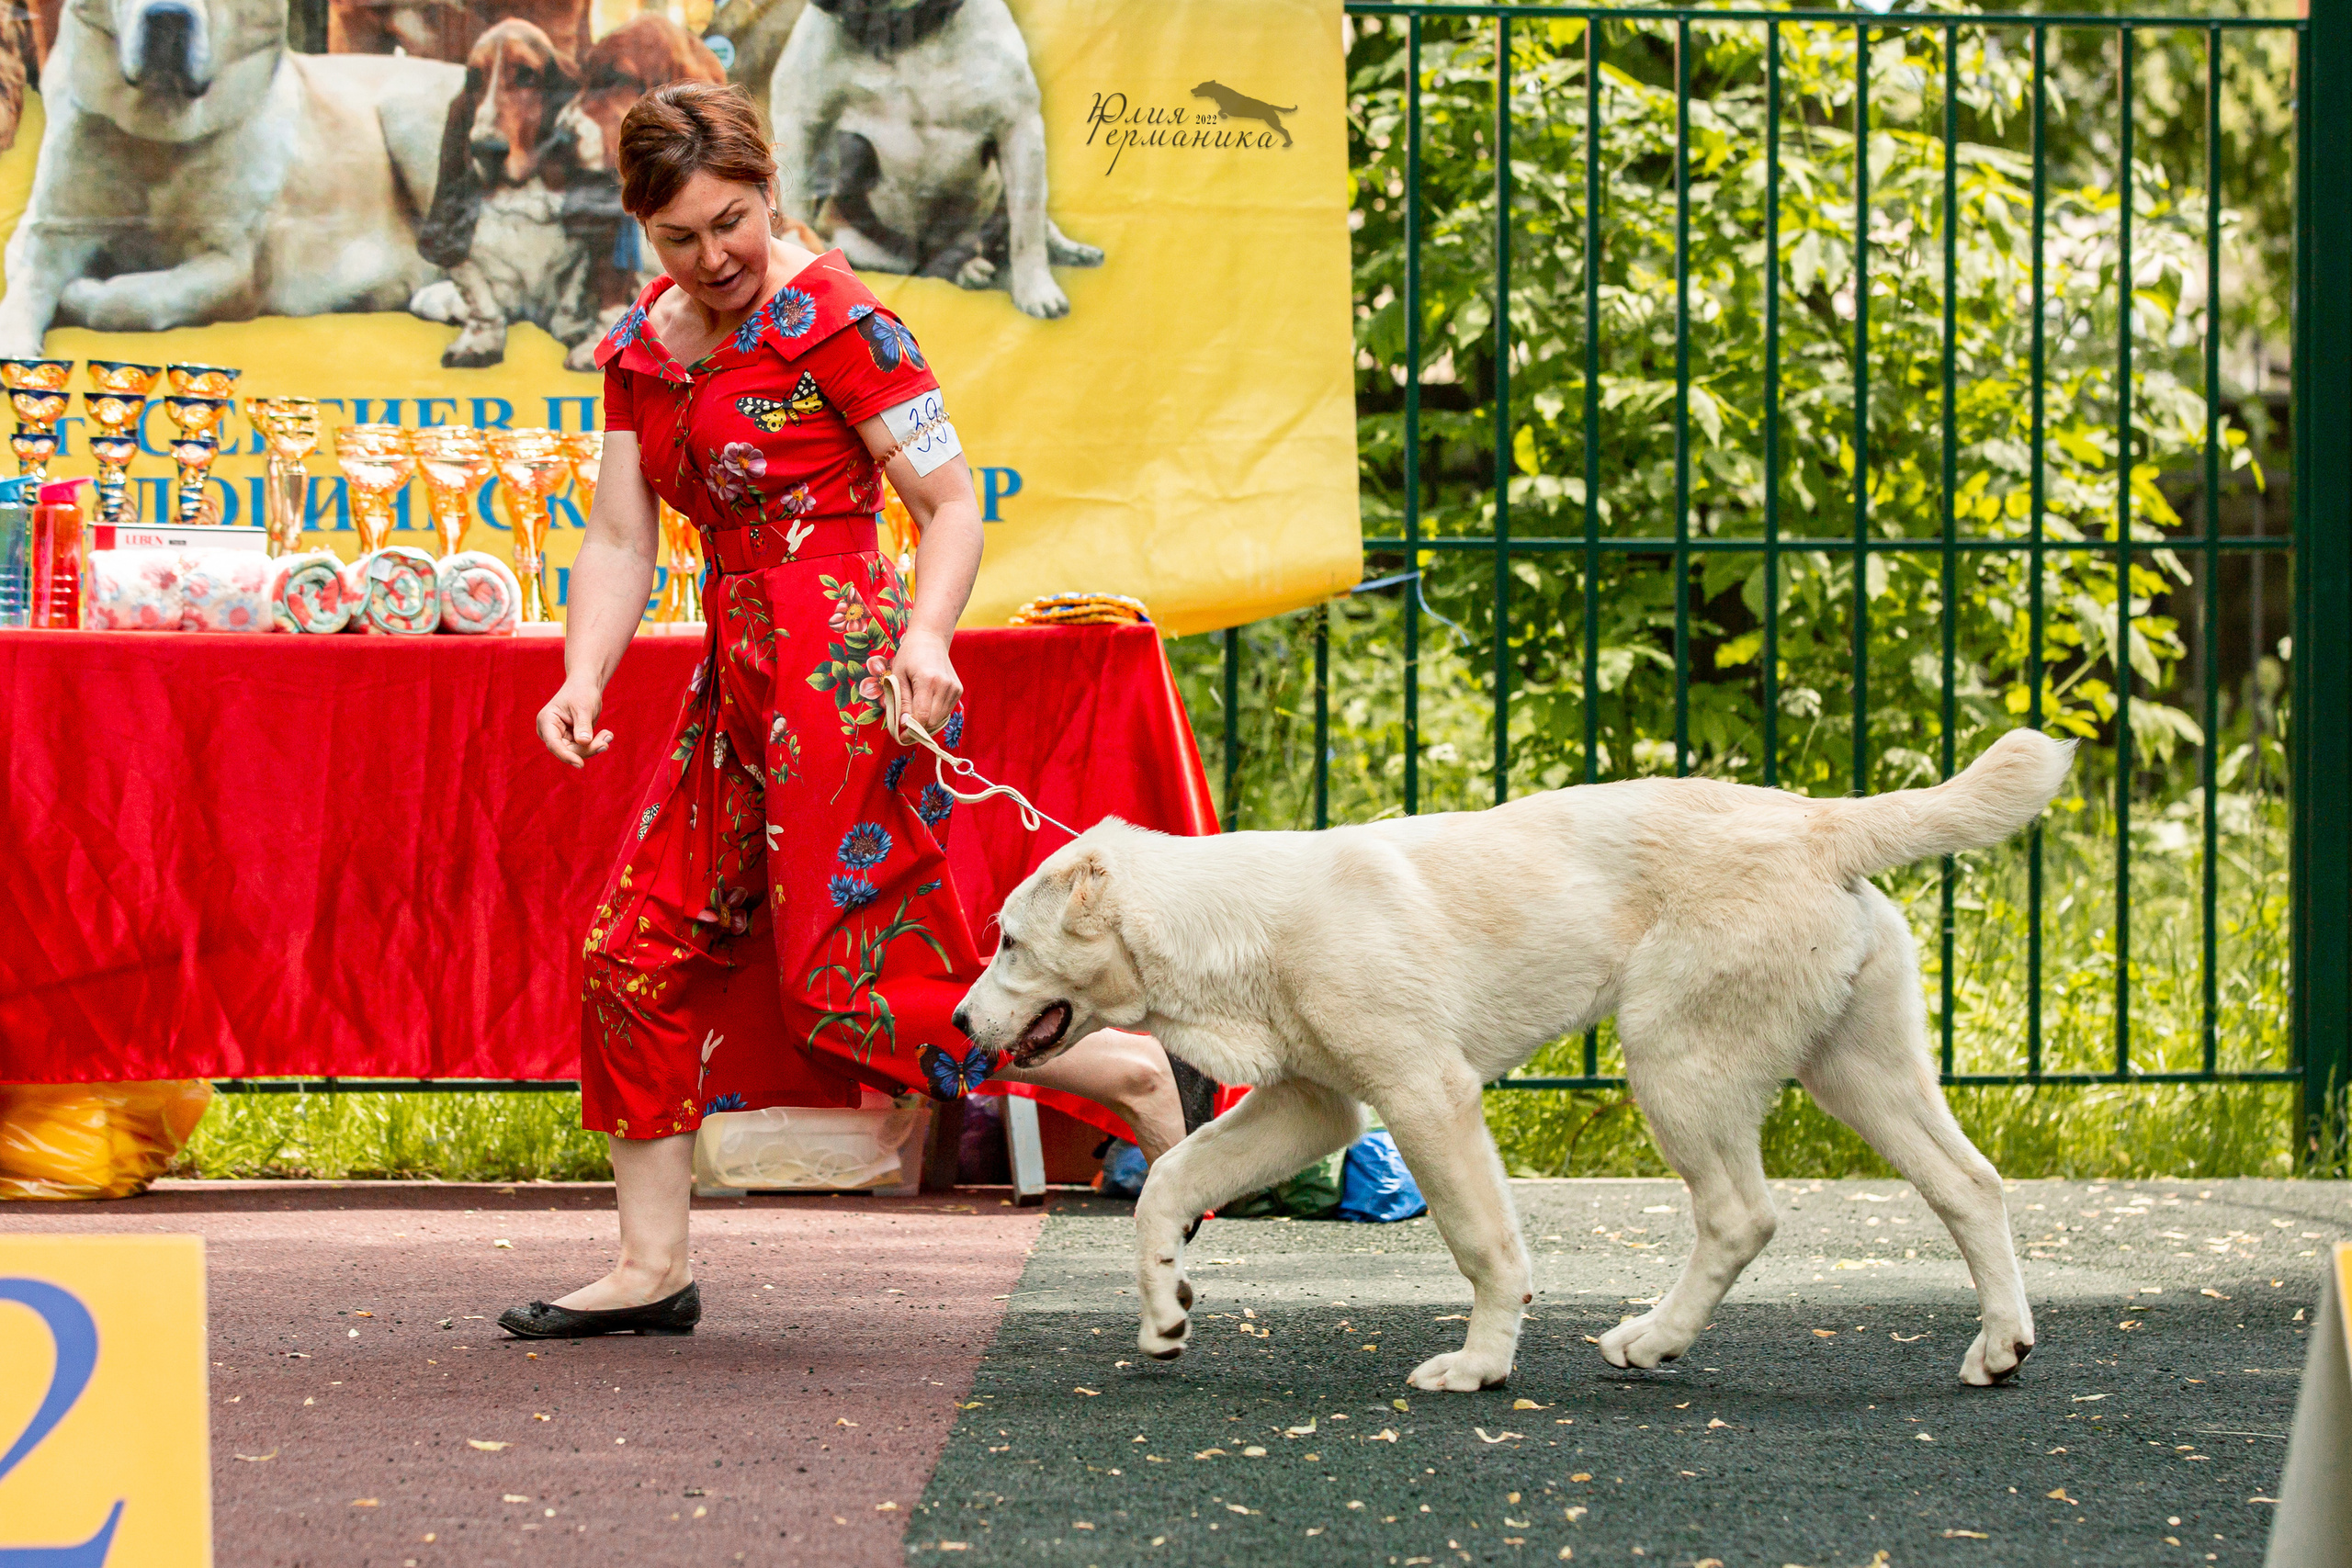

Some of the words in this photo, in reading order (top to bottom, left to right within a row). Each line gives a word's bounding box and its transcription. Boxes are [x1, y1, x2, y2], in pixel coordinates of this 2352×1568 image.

[909, 397, 947, 453] 39
[125, 535, 164, 546] LEBEN
[0, 1277, 126, 1568] 2
